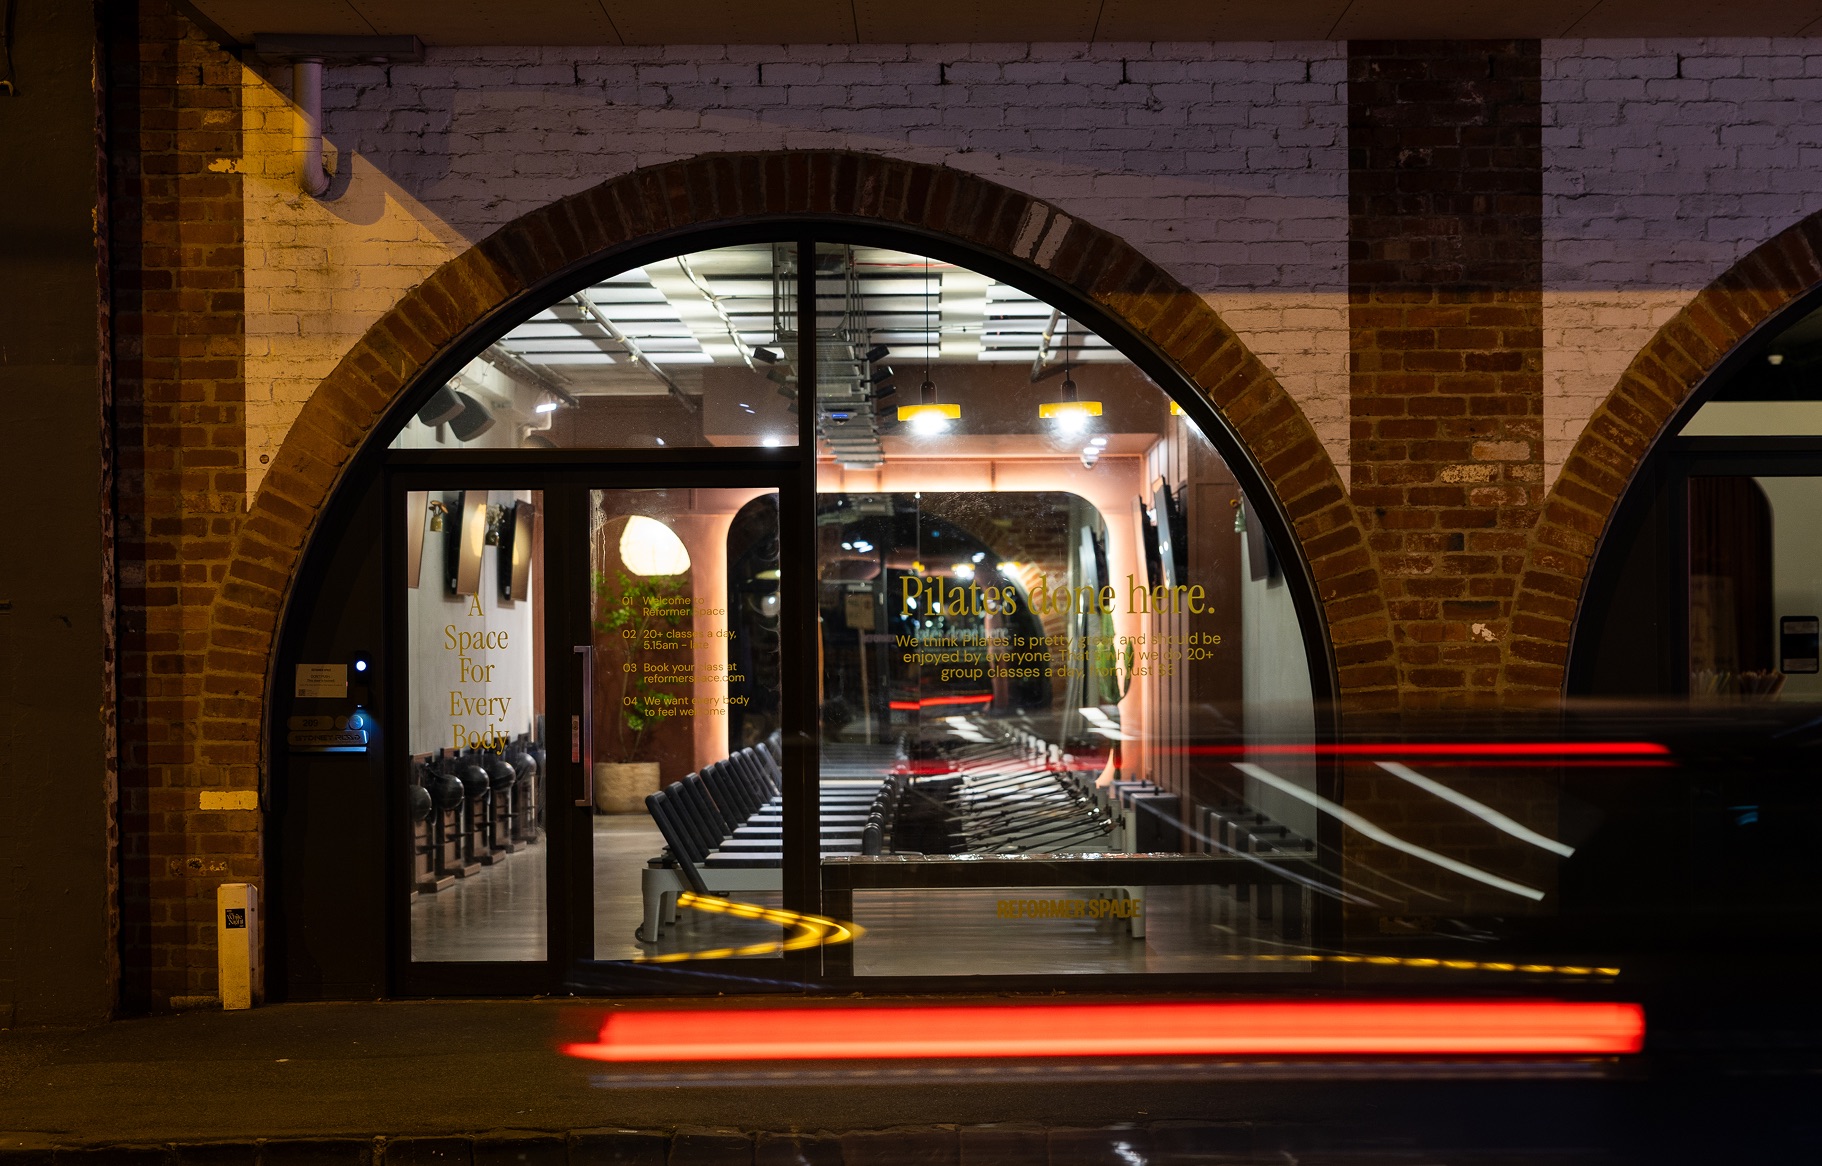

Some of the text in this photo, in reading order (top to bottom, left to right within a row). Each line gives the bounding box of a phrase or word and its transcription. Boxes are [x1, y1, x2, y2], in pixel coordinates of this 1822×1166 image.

[621, 596, 704, 606] 01 Welcome to
[899, 573, 1215, 616] Pilates done here.
[468, 591, 484, 617] A
[643, 607, 725, 618] Reformer Space
[444, 624, 509, 656] Space
[622, 630, 637, 639] 02
[643, 630, 664, 639] 20+
[666, 629, 704, 639] classes
[716, 629, 737, 640] day,
[895, 632, 1222, 650] We think Pilates is pretty great and should be
[643, 640, 679, 650] 5.15am
[690, 640, 709, 649] late
[903, 647, 1214, 666] enjoyed by everyone. Thats why we do 20+
[459, 657, 495, 683] For
[623, 662, 737, 674] 03 Book your lass at
[941, 667, 983, 682] group
[987, 665, 1040, 678] classes
[1044, 668, 1053, 678] a
[1057, 664, 1086, 680] day,
[1089, 664, 1123, 677] from
[1126, 664, 1153, 680] just
[643, 674, 745, 684] reformersce.com
[449, 691, 511, 722] Every
[623, 696, 638, 706] 04
[644, 697, 661, 706] We
[663, 696, 689, 706] want
[722, 695, 750, 707] body
[644, 707, 726, 717] to feel welome
[452, 723, 510, 756] Body
[997, 898, 1142, 919] REFORMER SPACE
